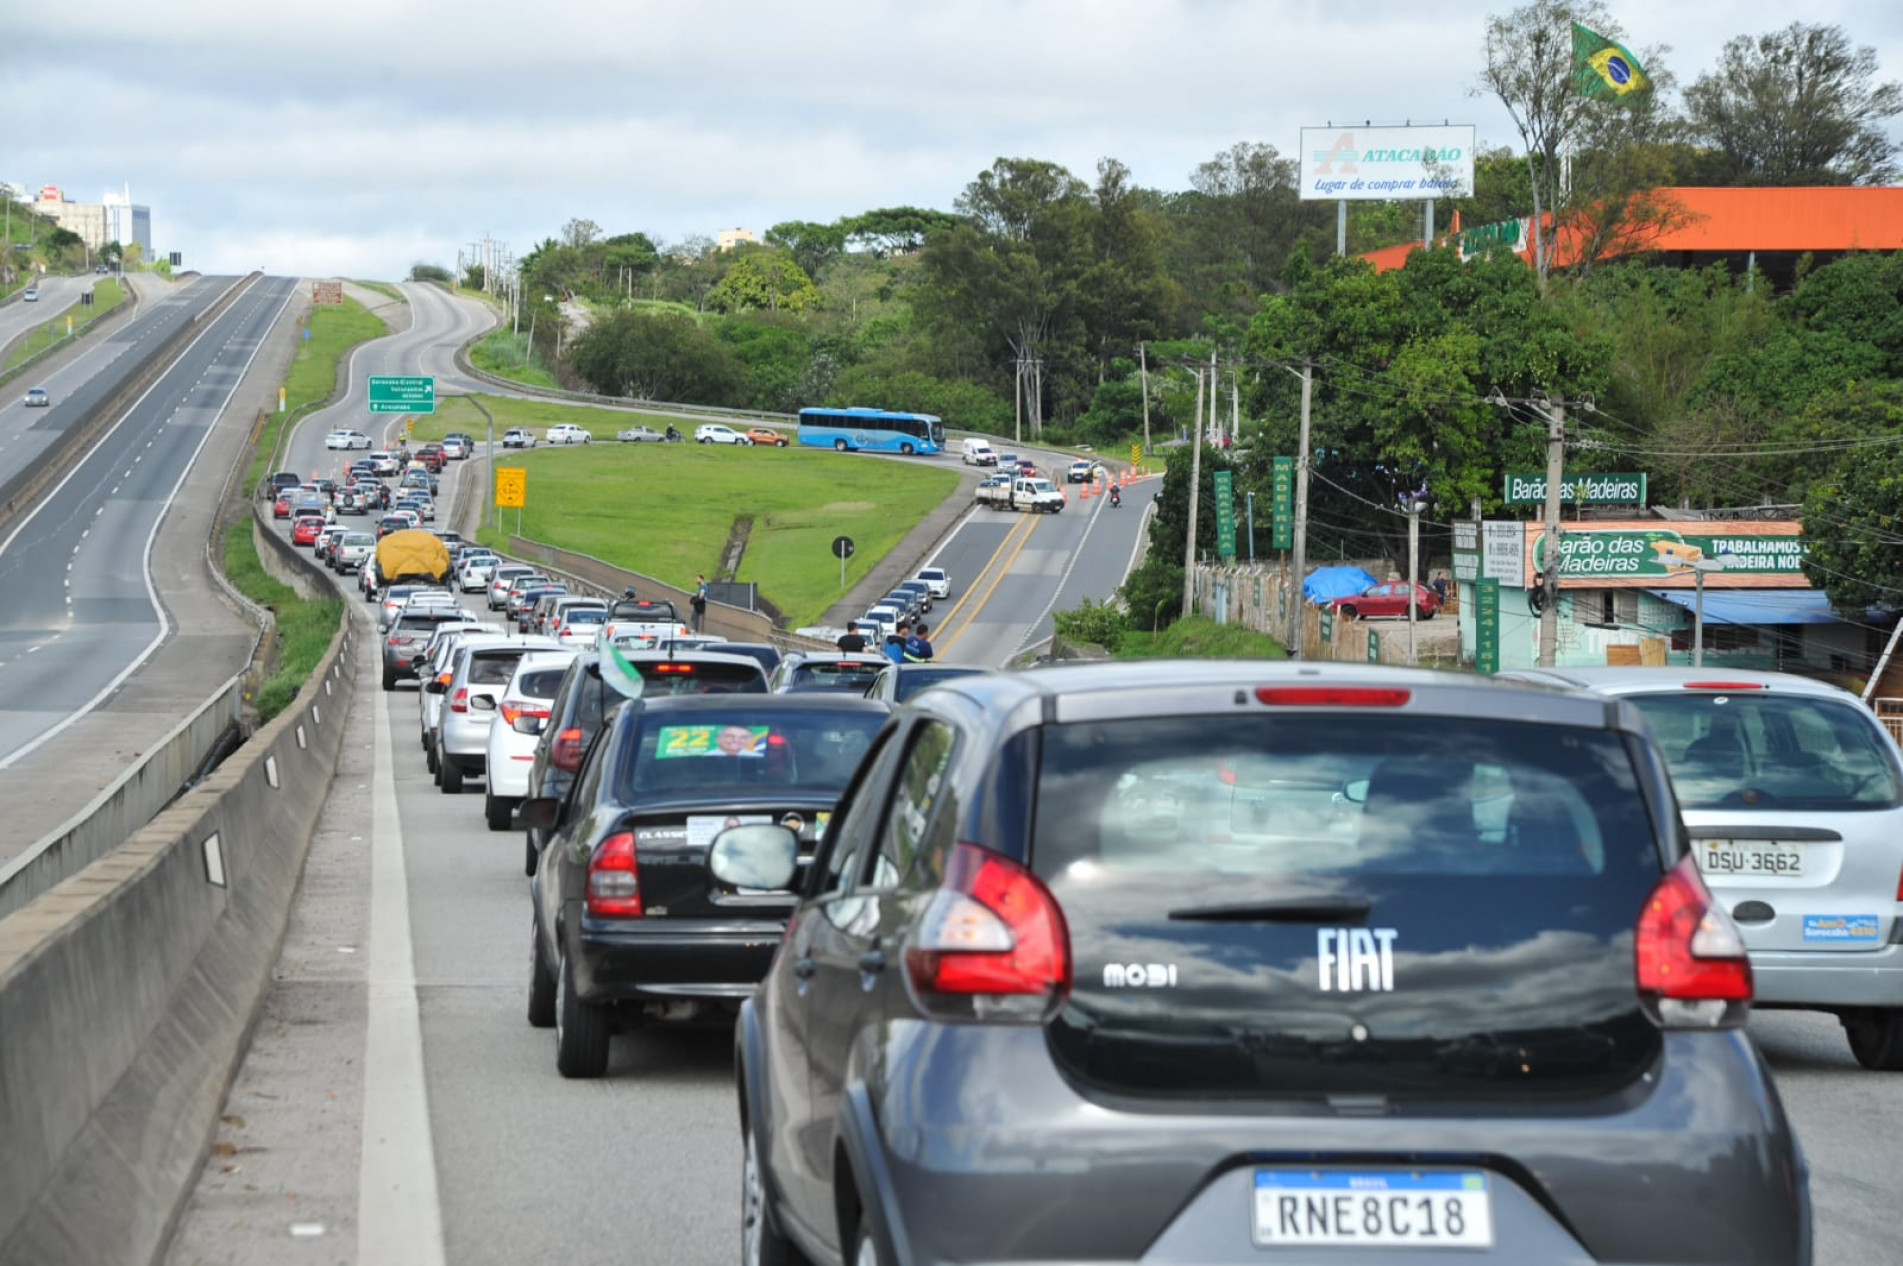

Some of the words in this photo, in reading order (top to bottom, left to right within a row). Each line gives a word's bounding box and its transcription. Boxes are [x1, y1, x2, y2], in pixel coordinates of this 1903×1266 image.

[1314, 178, 1347, 194] Lugar
[1349, 177, 1365, 190] de
[1367, 180, 1416, 192] comprar
[1512, 478, 1548, 499] Barão
[1559, 483, 1575, 499] as
[1557, 535, 1604, 554] arão
[1608, 536, 1645, 554] das
[668, 729, 710, 748] 22
[1317, 928, 1399, 992] FIAT
[1102, 963, 1178, 988] MOBI
[1278, 1195, 1466, 1237] RNE8C18
